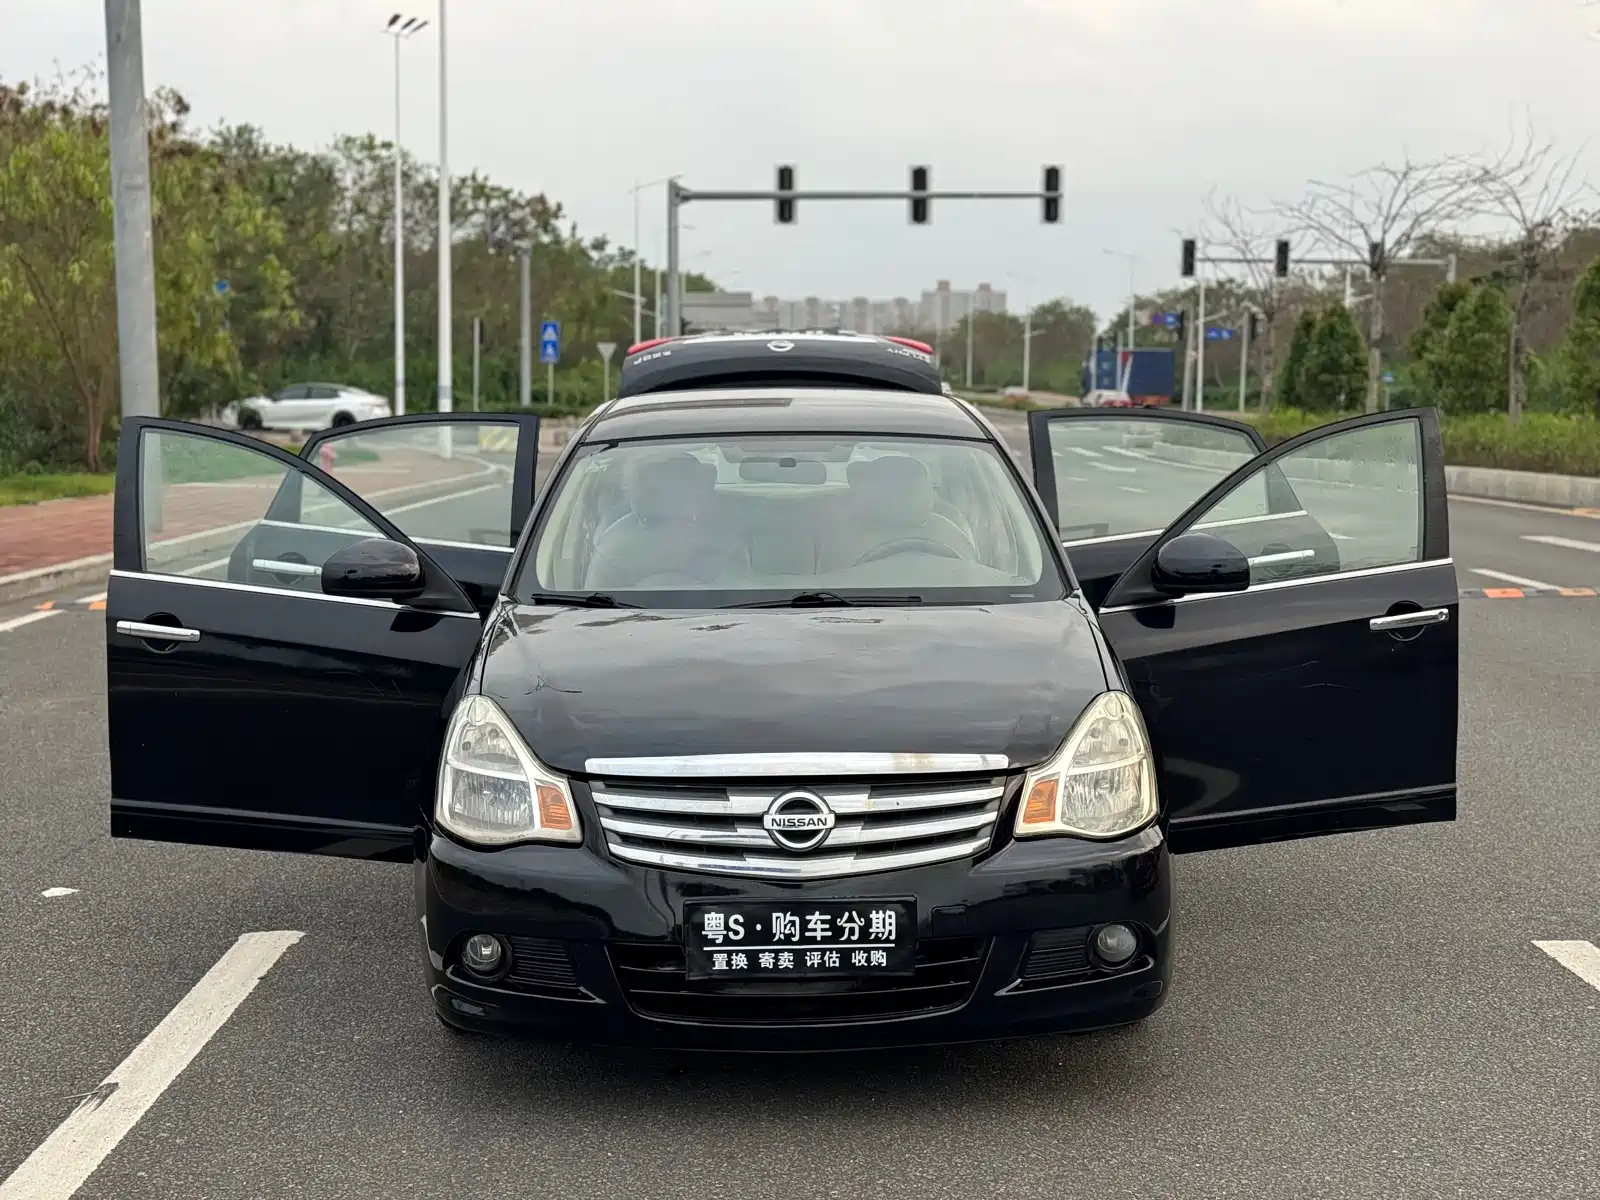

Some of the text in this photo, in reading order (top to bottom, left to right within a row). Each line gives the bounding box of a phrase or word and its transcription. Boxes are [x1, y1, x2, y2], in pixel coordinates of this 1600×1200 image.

[771, 817, 828, 827] NISSAN
[712, 950, 887, 970] 置换 寄卖 评估 收购
